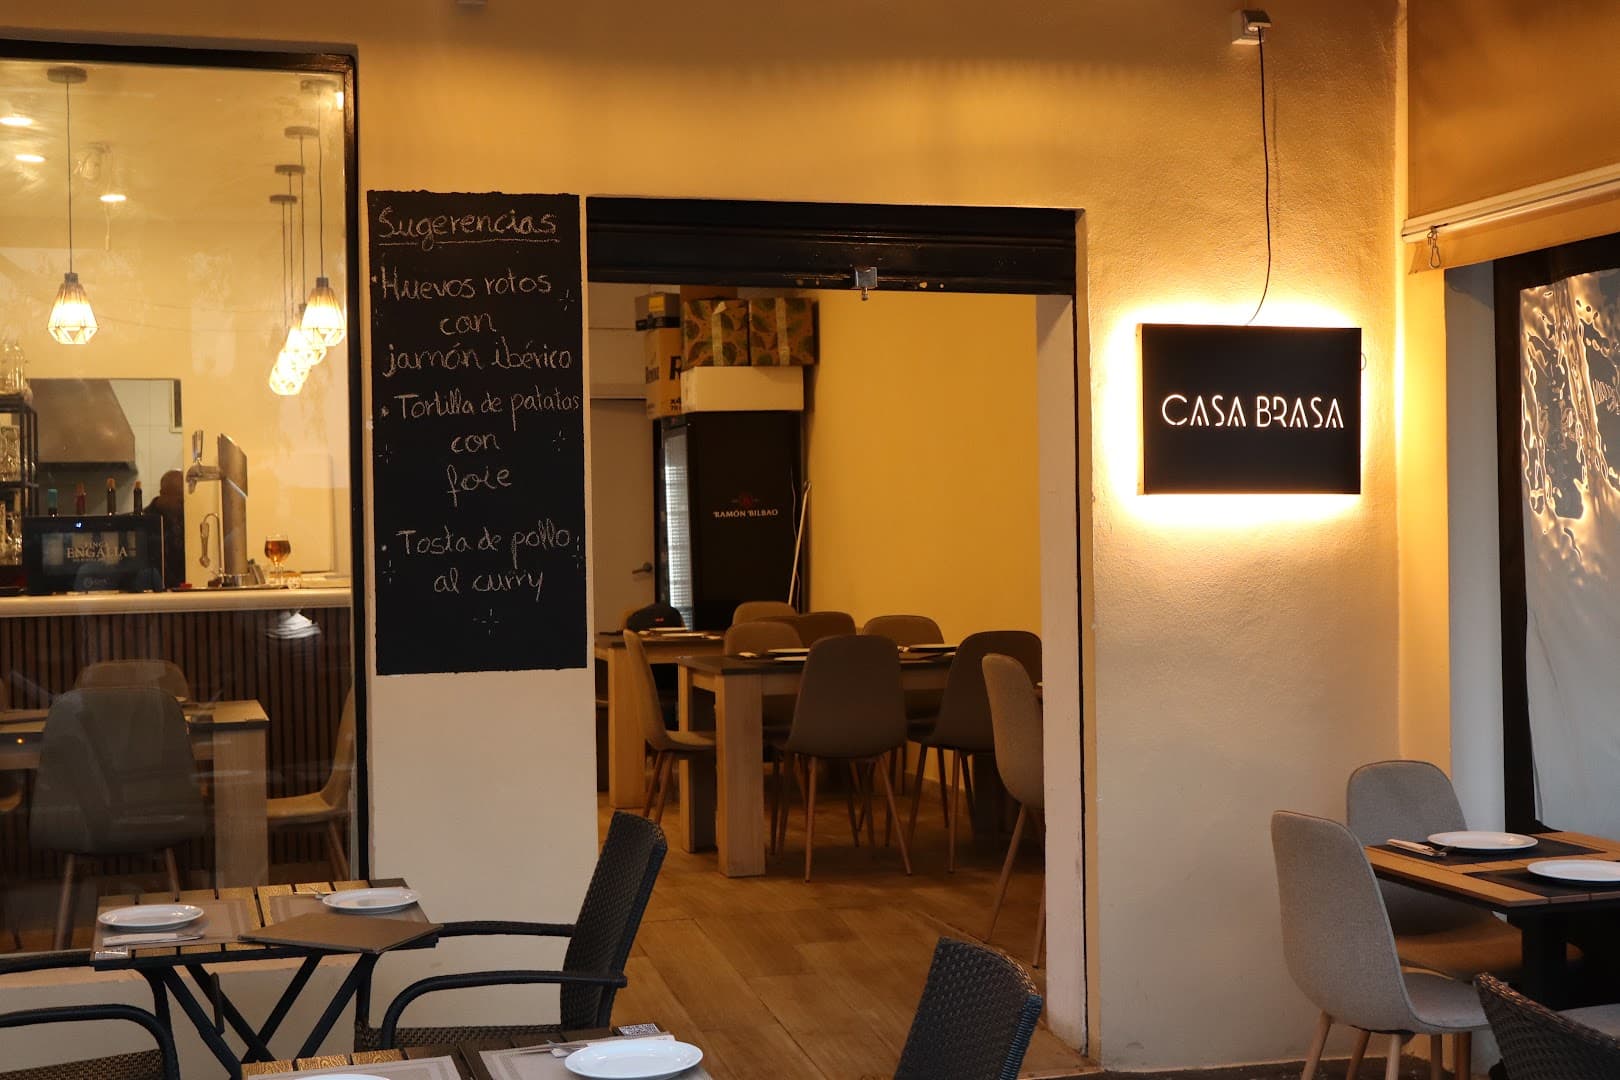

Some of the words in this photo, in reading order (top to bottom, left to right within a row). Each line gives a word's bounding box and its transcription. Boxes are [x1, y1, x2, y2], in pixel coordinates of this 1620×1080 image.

[378, 206, 557, 250] Sugerencias
[381, 265, 476, 301] Huevos
[485, 267, 552, 294] rotos
[439, 312, 496, 335] con
[382, 341, 483, 378] jamón
[491, 336, 572, 369] ibérico
[394, 387, 475, 419] Tortilla
[480, 392, 502, 413] de
[511, 384, 581, 431] patatas
[1161, 394, 1247, 427] CASA
[1256, 395, 1344, 429] BRASA
[451, 432, 500, 453] con
[447, 464, 512, 507] foie
[747, 508, 778, 517] BILBAO
[396, 525, 472, 555] Tosta
[478, 526, 501, 551] de
[512, 518, 570, 570] pollo
[434, 567, 460, 594] al
[472, 570, 544, 602] curry
